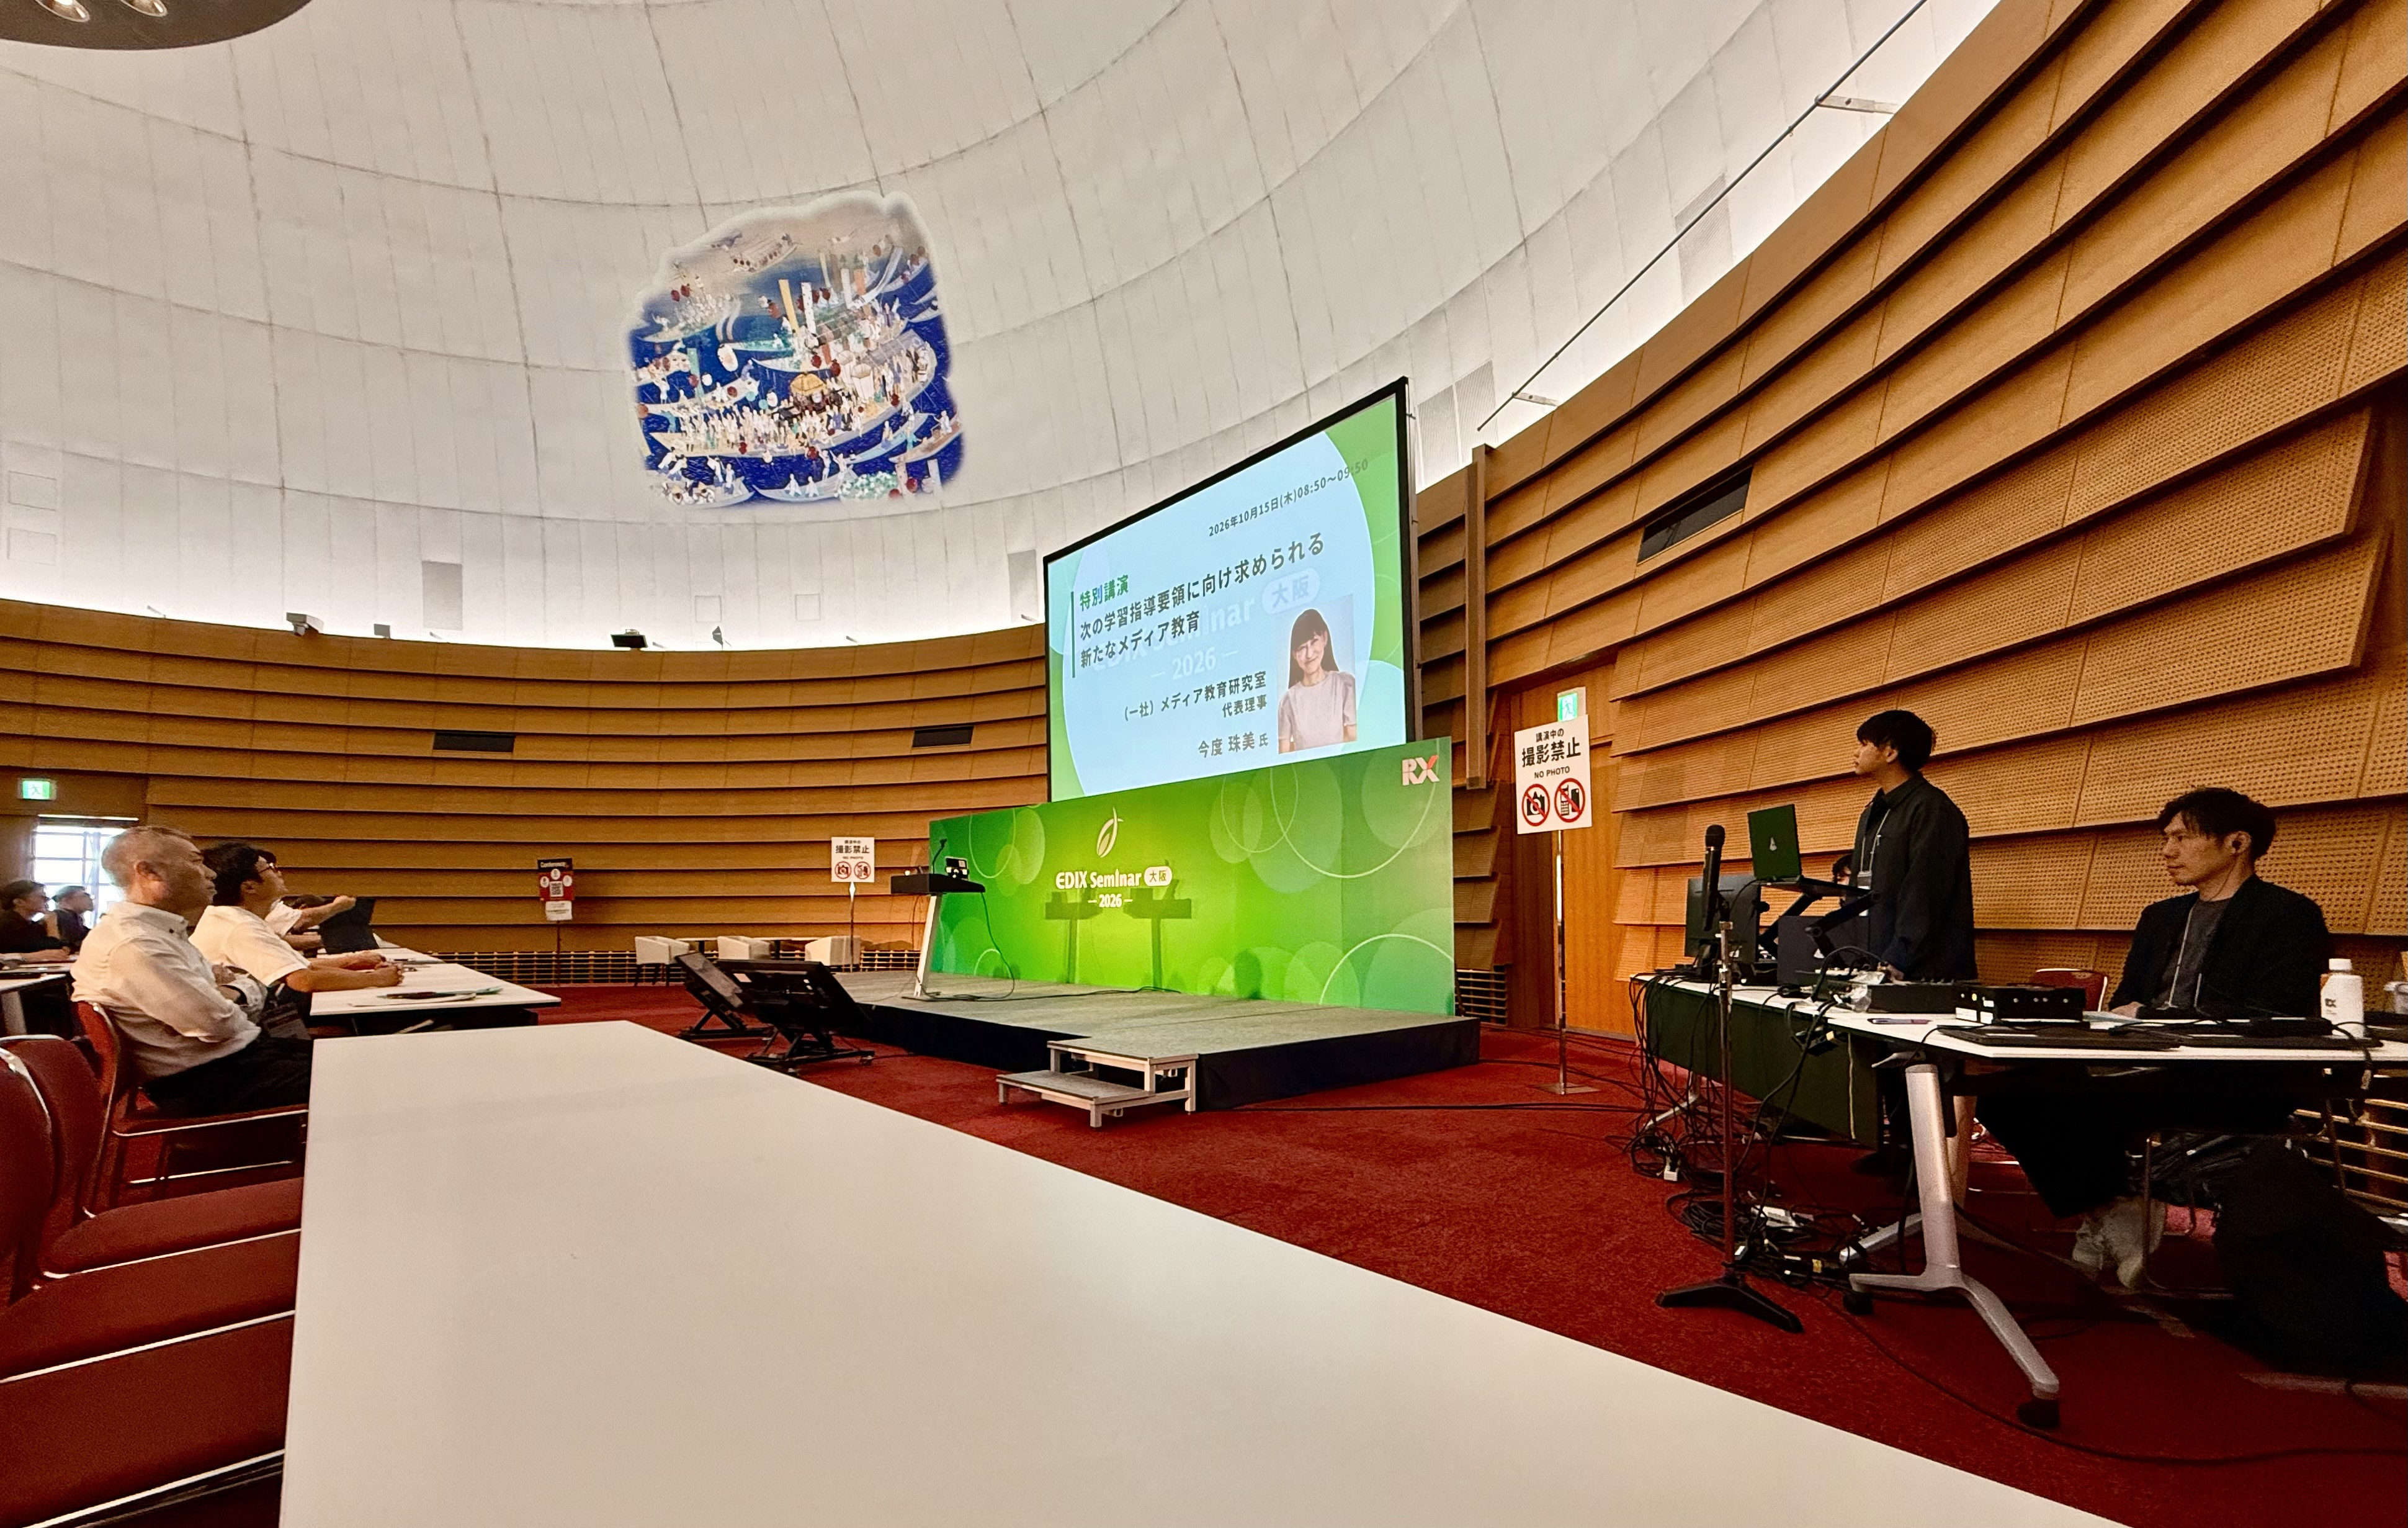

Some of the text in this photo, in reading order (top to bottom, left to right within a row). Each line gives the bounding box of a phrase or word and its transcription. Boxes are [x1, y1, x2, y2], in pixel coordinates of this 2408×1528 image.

[1080, 532, 1323, 640] 次の学習指導要領に向け求められる
[1080, 575, 1129, 611] 特別講演
[1273, 575, 1309, 608] 大阪
[1081, 611, 1199, 668] 新たなメディア教育
[1222, 694, 1267, 718] 代表理事
[1536, 728, 1564, 742] 講演中の
[1522, 737, 1581, 768] 撮影禁止
[1402, 755, 1439, 786] RX
[1534, 766, 1570, 778] NO PHOTO
[1055, 868, 1167, 889] EDIX Seminar 大阪
